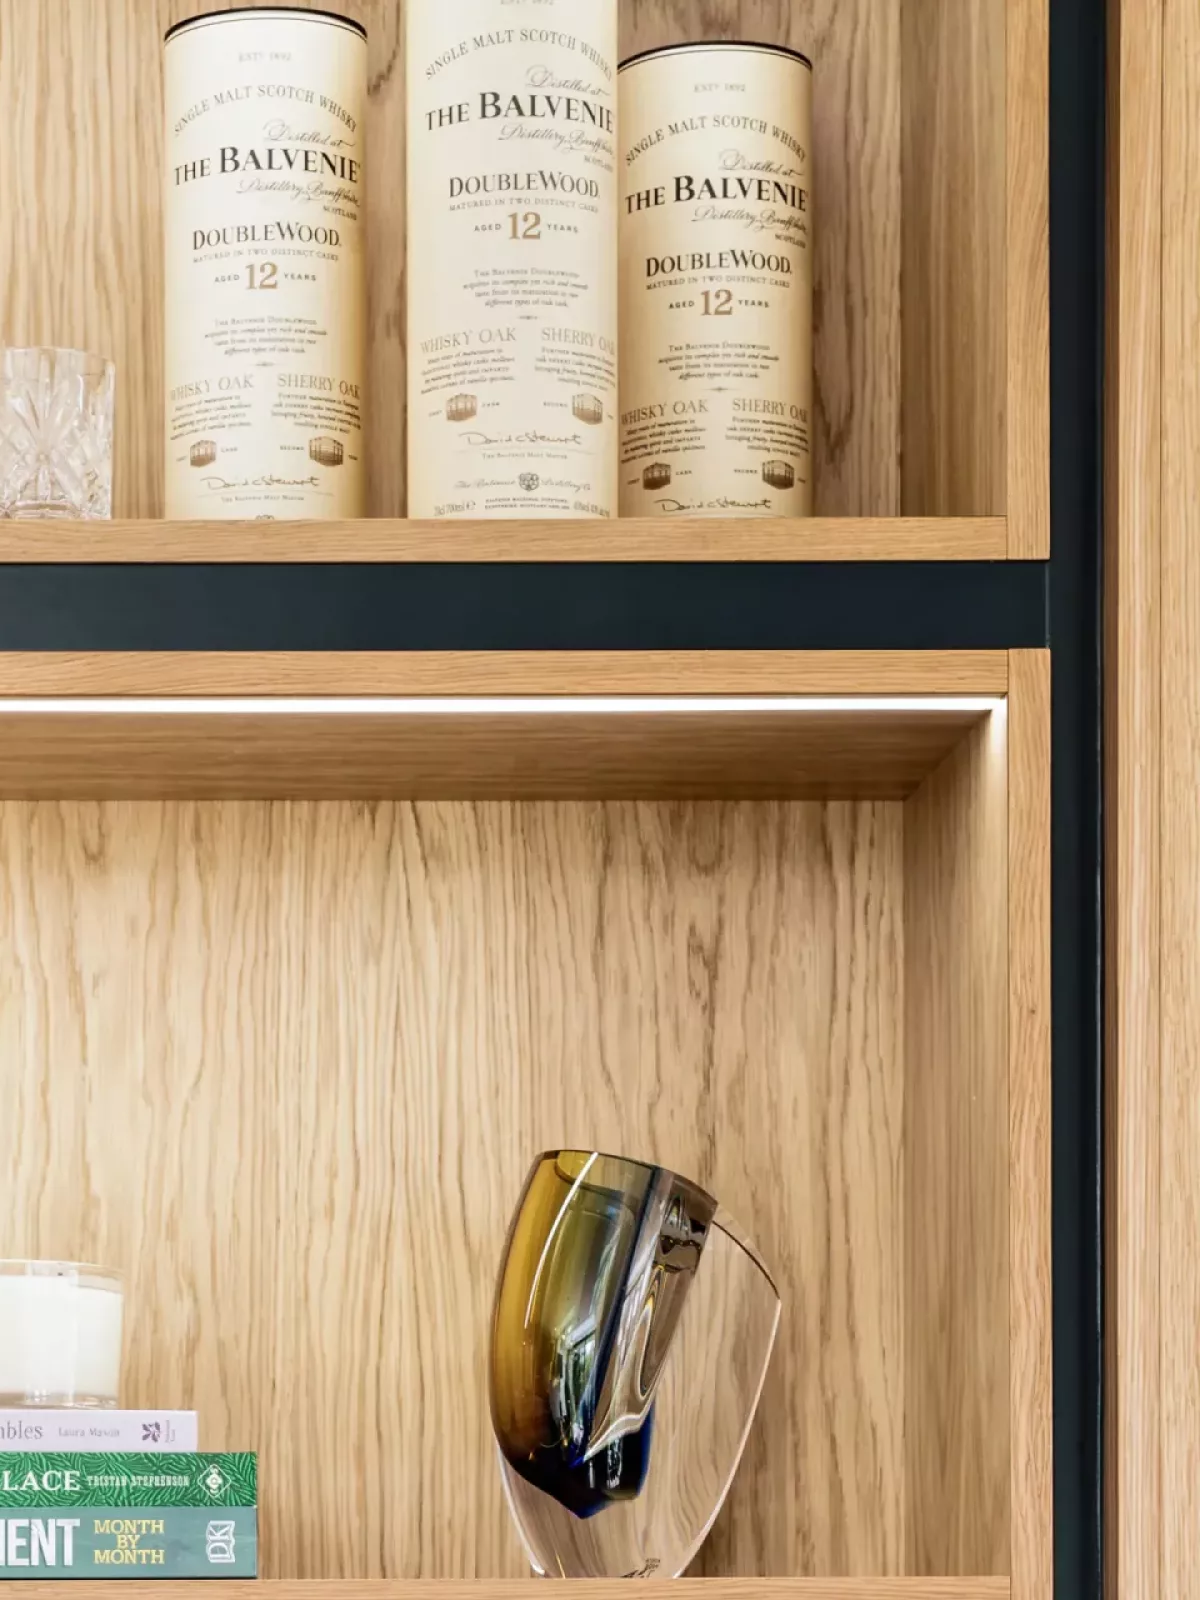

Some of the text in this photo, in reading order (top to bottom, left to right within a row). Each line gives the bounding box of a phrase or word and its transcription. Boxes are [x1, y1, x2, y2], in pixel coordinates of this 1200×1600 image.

[425, 41, 469, 80] SINGLE
[473, 29, 514, 50] MALT
[520, 28, 576, 51] SCOTCH
[525, 64, 590, 95] Distilled
[174, 84, 357, 135] SINGLE MALT SCOTCH WHISKY
[425, 91, 613, 134] THE BALVENIE
[263, 118, 328, 146] Distilled
[625, 114, 806, 166] SINGLE MALT SCOTCH WHISKY
[174, 146, 360, 186] THE BALVENIE
[718, 148, 780, 175] Distilled
[450, 199, 491, 211] MATURED
[494, 198, 505, 206] IN
[509, 198, 530, 206] TWO
[534, 198, 576, 209] DISTINCT
[625, 174, 807, 215] THE BALVENIE
[474, 212, 579, 240] AGED 12 YEARS
[193, 248, 339, 264] MATURED IN TWO DISTINCT CASKS
[214, 261, 317, 290] AGED 12 YEARS
[646, 275, 790, 290] MATURED IN TWO DISTINCT CASKS
[668, 289, 769, 316] AGED 12 YEARS
[420, 327, 517, 354] WHISKY OAK
[541, 326, 595, 347] SHERRY
[218, 373, 255, 391] OAK
[277, 373, 360, 400] SHERRY OAK
[621, 399, 709, 426] WHISKY OAK
[732, 398, 808, 424] SHERRY OAK
[58, 1427, 85, 1437] Laura
[87, 1475, 127, 1487] TRISTAN
[132, 1475, 189, 1487] STEPHENSON
[93, 1519, 165, 1535] MONTH
[116, 1534, 141, 1550] BY
[207, 1520, 235, 1563] DK
[93, 1549, 165, 1565] MONTH
